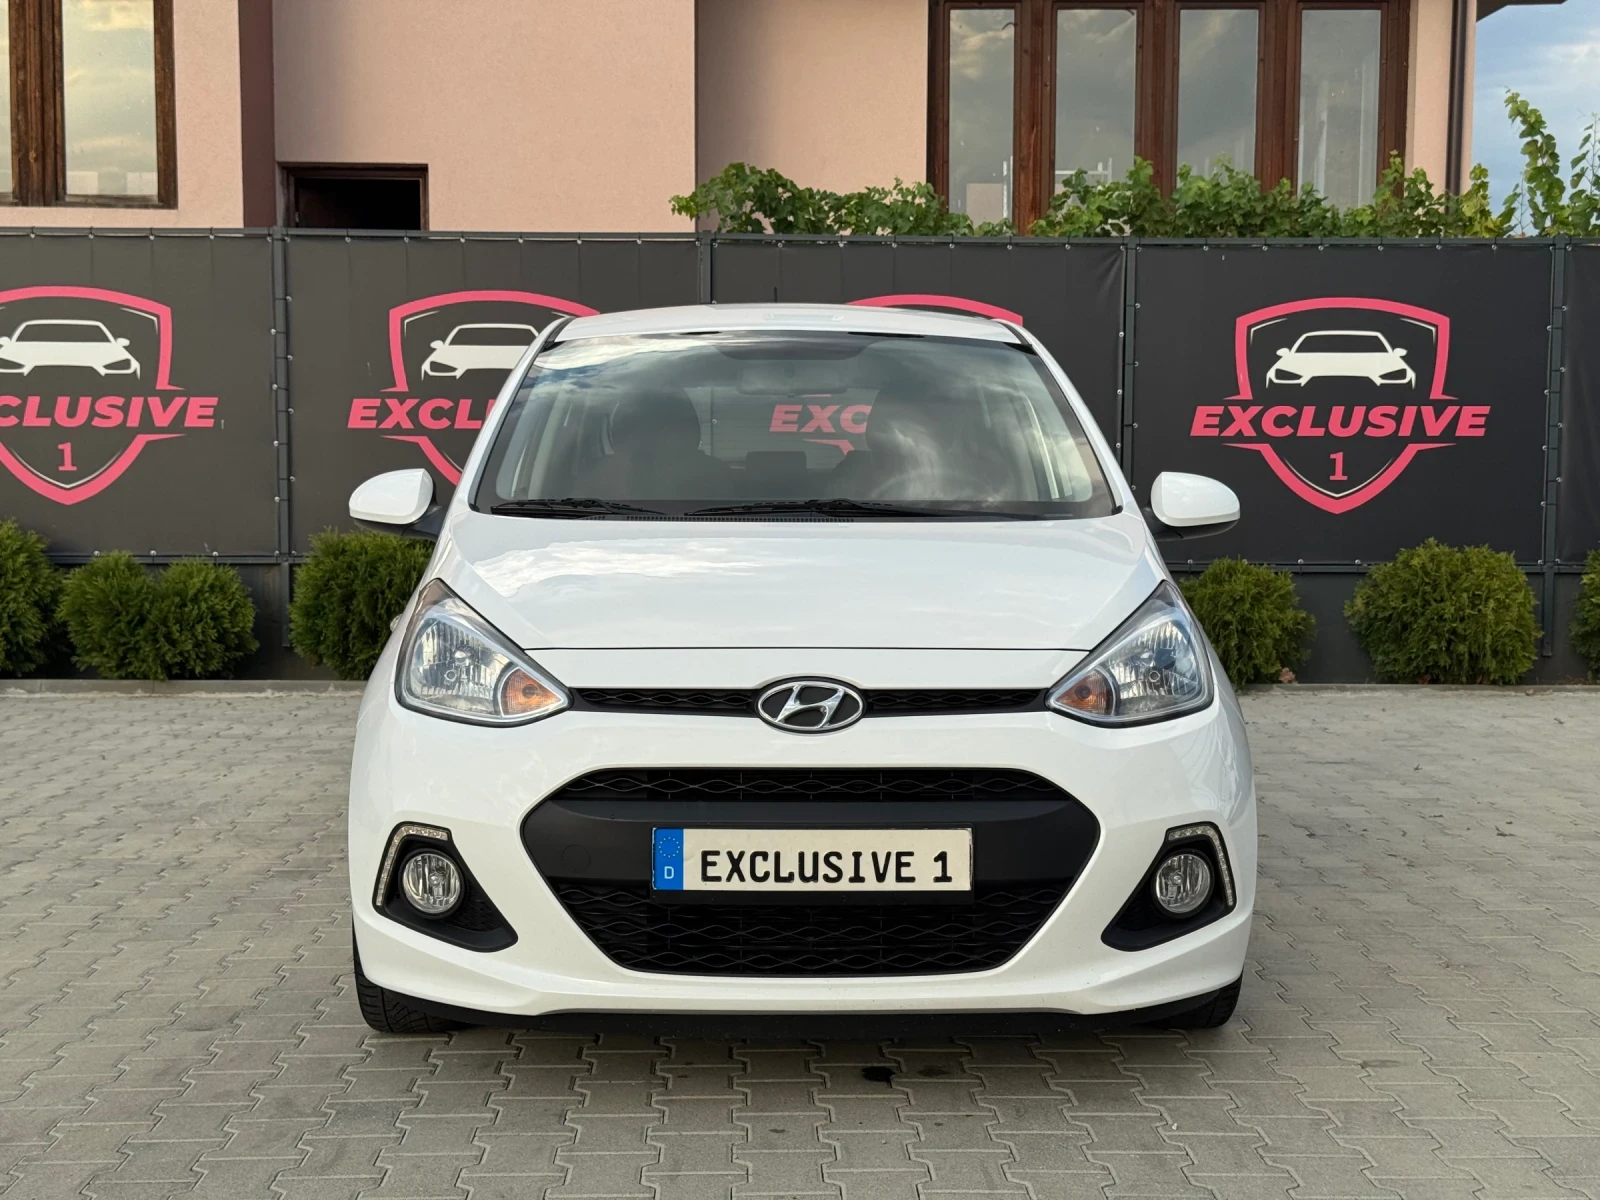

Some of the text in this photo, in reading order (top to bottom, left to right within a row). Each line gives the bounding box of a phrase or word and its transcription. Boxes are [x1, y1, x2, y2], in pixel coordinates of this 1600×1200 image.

[347, 398, 495, 430] EXCL
[1190, 405, 1491, 438] EXCLUSIVE
[58, 442, 77, 471] 1
[1329, 451, 1348, 481] 1
[664, 866, 675, 880] D
[700, 850, 953, 884] EXCLUSIVE 1
